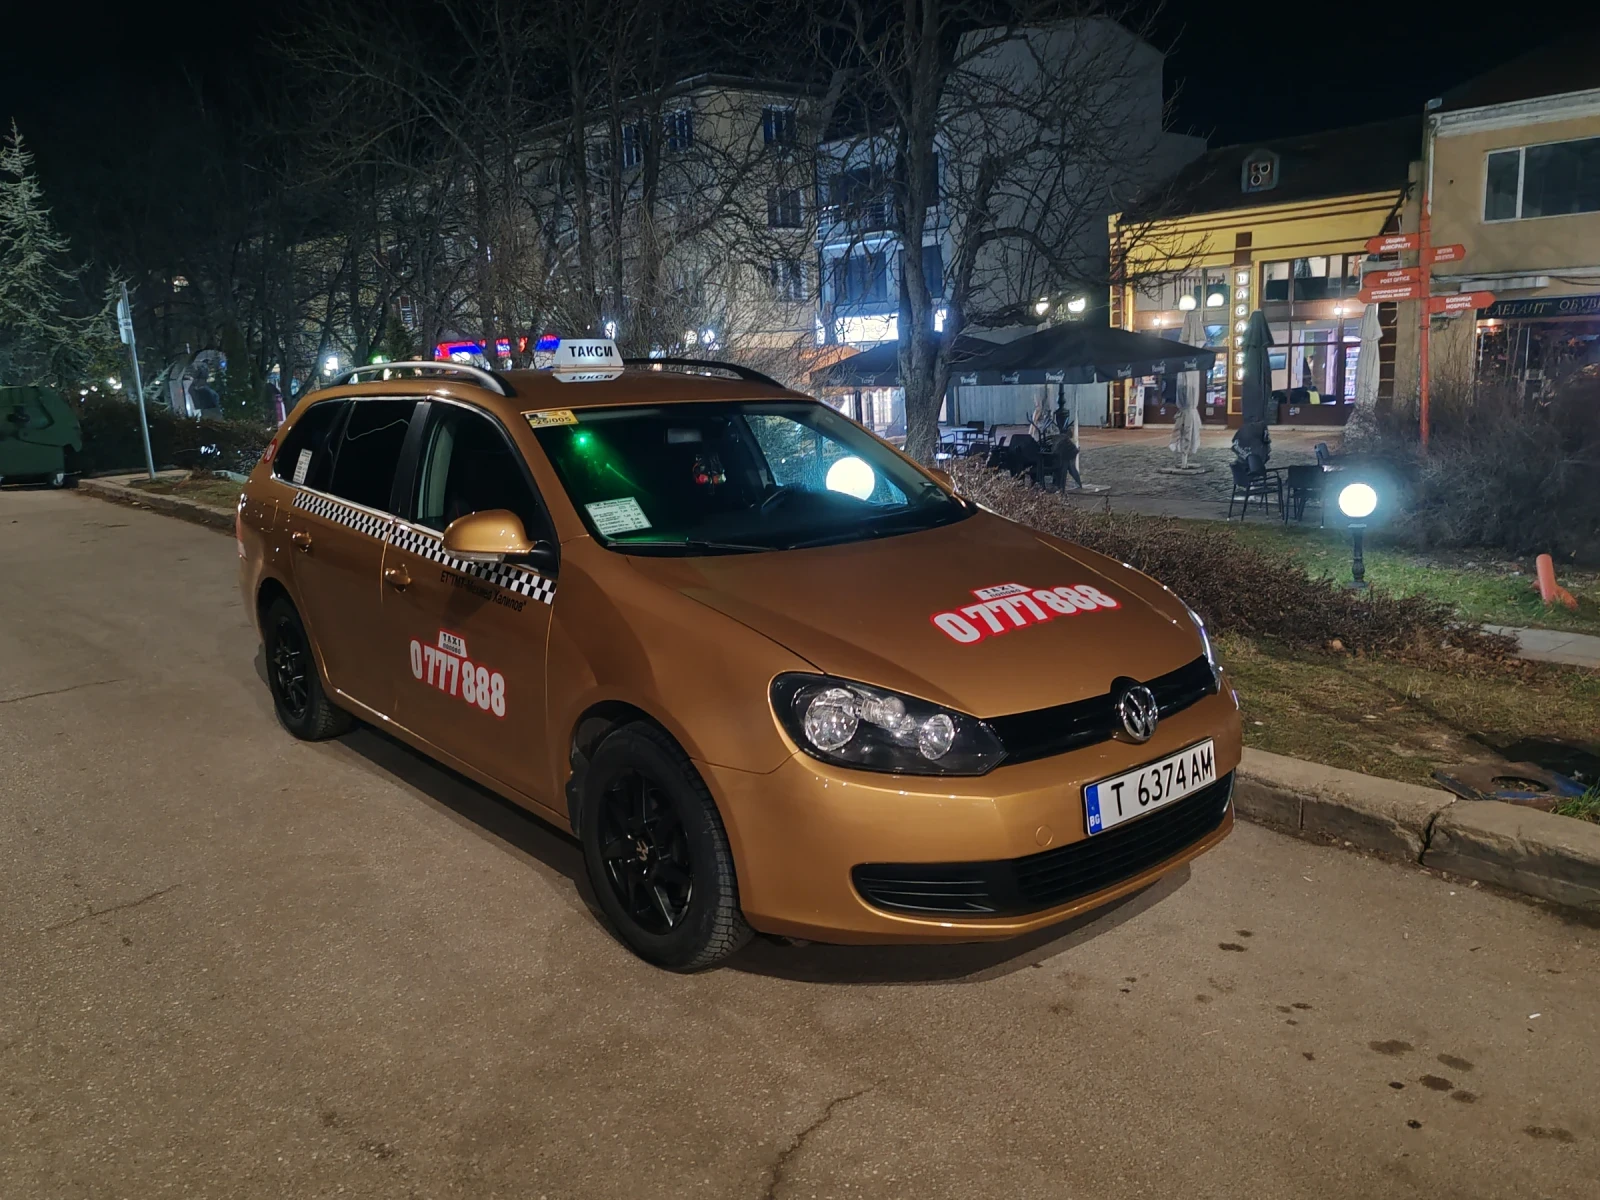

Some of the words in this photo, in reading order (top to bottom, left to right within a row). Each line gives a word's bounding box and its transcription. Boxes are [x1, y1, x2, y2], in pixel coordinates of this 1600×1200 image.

[1380, 242, 1411, 251] MUNICIPALITY
[1446, 302, 1472, 310] HOSPITAL
[1559, 298, 1600, 311] ОБУВ
[569, 346, 613, 358] ТАКСИ
[982, 584, 1016, 595] TAXI
[442, 633, 461, 647] TAXI
[1110, 781, 1125, 817] T
[1138, 758, 1187, 806] 6374
[1191, 746, 1213, 786] AM
[1089, 814, 1101, 827] BG
